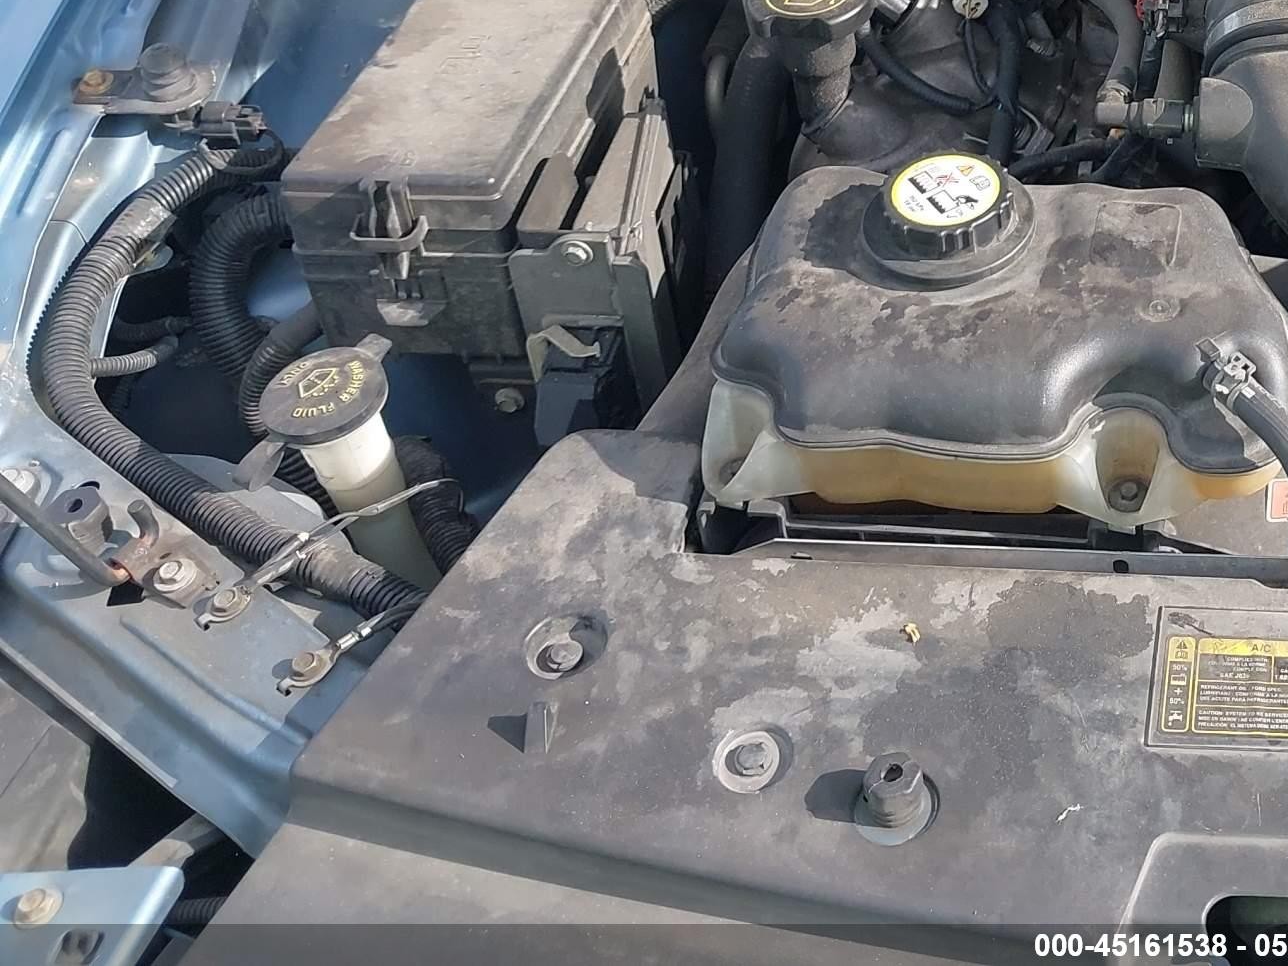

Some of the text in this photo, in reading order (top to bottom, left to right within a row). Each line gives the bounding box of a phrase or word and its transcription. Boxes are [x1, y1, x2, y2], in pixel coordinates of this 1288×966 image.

[274, 360, 364, 418] WASHER FLUID ONLY
[1252, 644, 1271, 652] A/C
